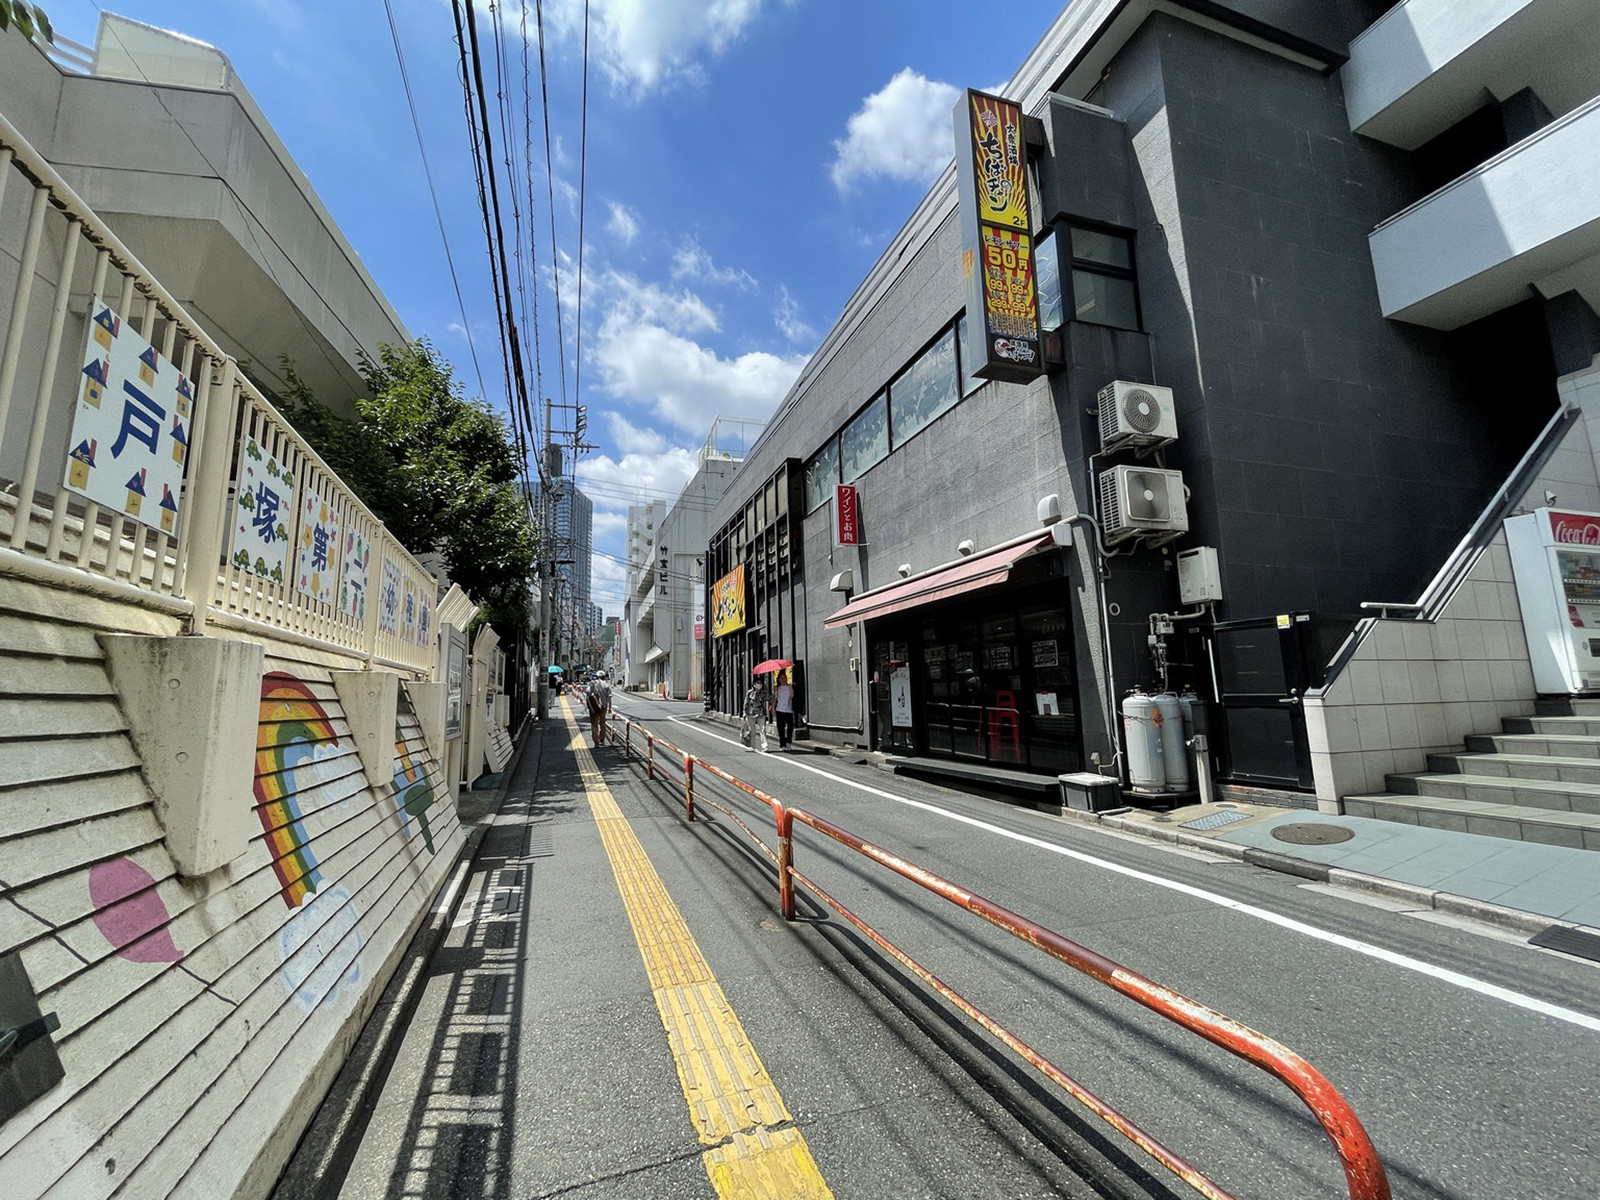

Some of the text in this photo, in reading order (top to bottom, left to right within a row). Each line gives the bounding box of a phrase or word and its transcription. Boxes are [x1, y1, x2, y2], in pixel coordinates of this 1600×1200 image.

[1012, 216, 1026, 226] 2F
[984, 234, 1028, 250] レモンサワー
[987, 245, 1028, 271] 50円
[111, 379, 166, 459] 戸
[252, 481, 280, 544] 塚
[311, 522, 330, 572] 第
[842, 487, 853, 541] ワインとお肉
